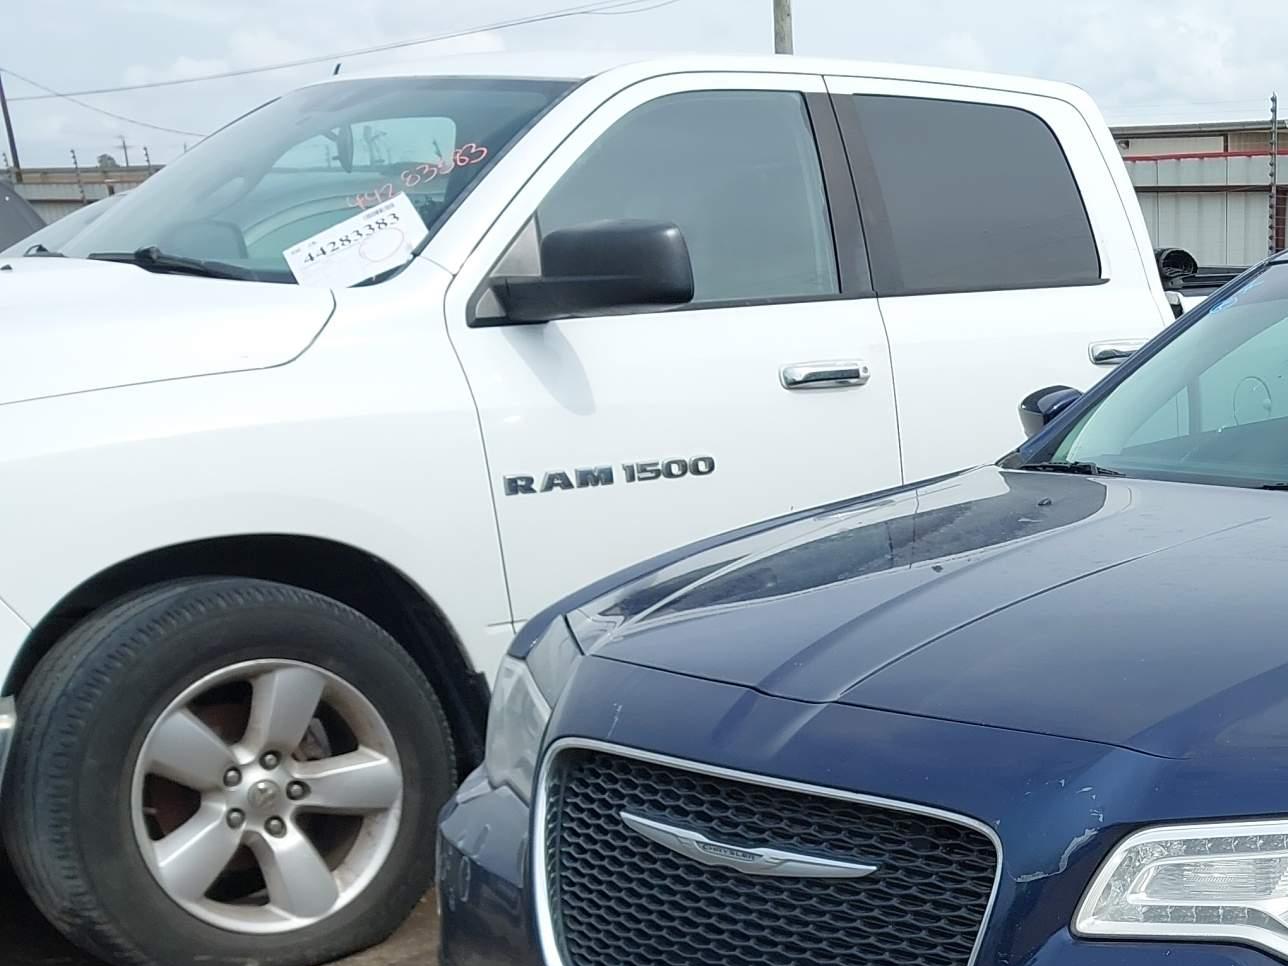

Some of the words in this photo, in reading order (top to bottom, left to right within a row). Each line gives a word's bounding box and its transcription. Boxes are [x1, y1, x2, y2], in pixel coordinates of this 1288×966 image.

[303, 212, 400, 264] 44283383
[503, 464, 615, 496] RAM
[621, 456, 716, 483] 1500
